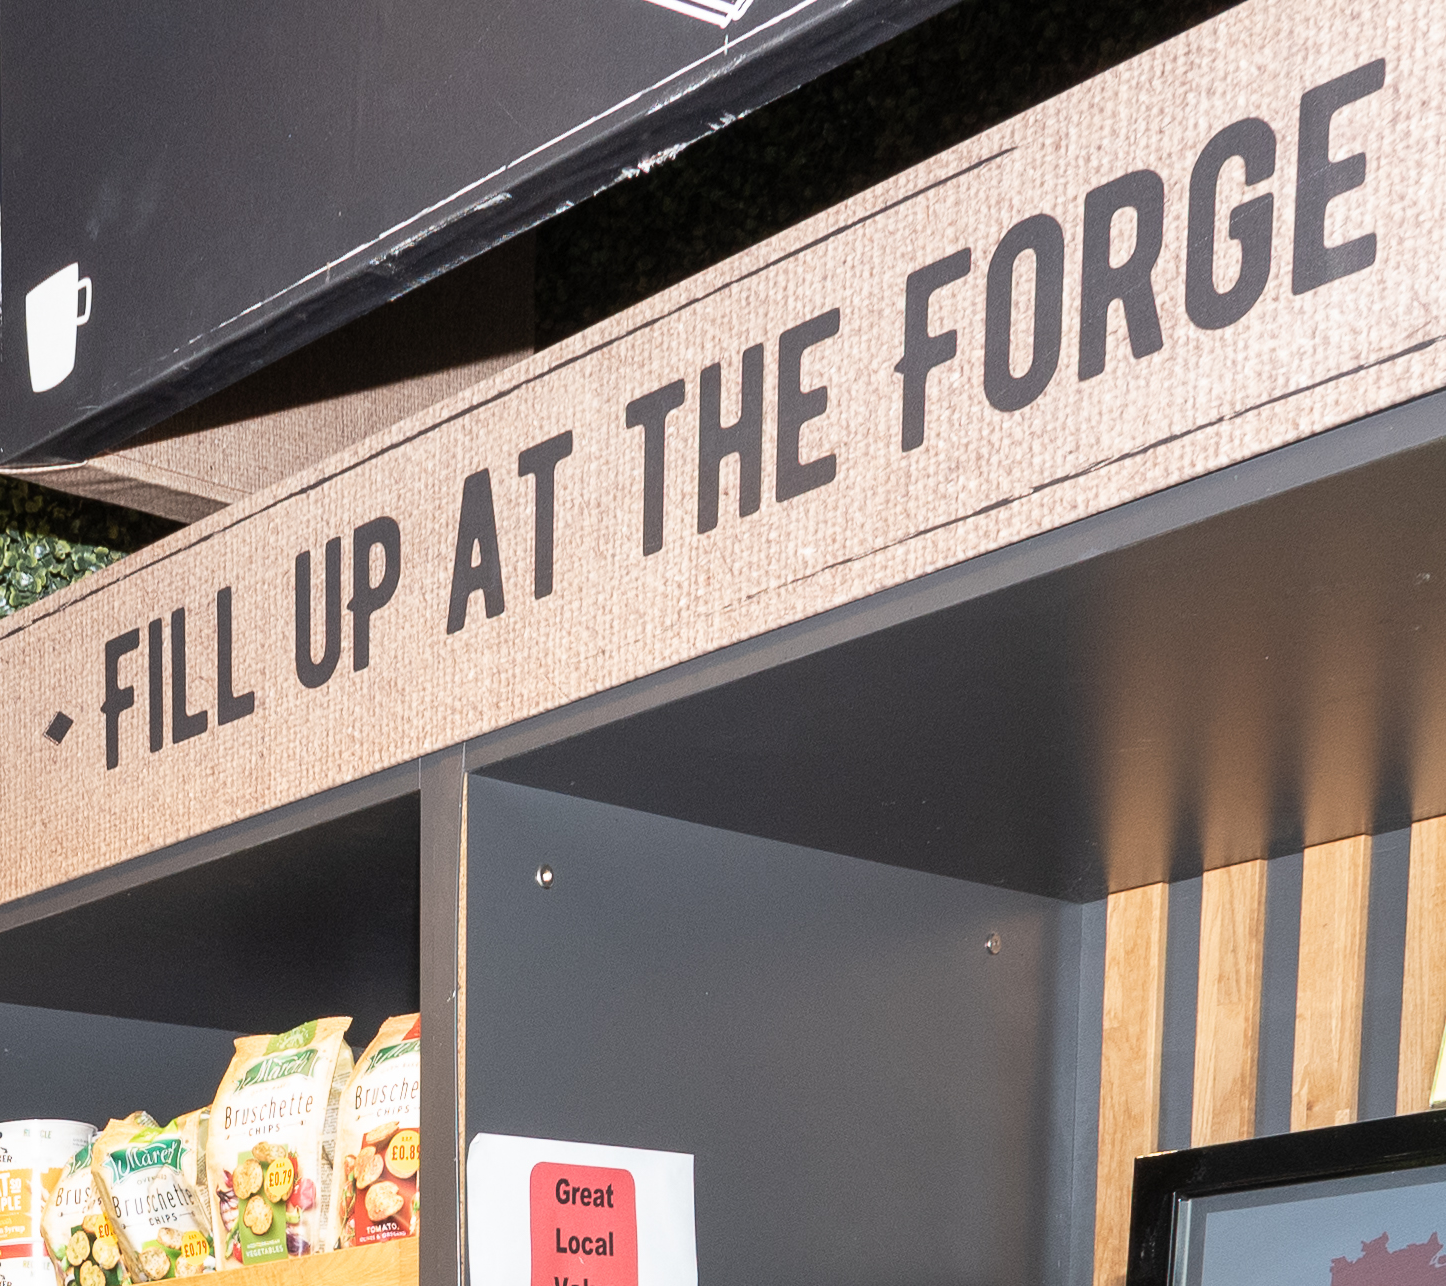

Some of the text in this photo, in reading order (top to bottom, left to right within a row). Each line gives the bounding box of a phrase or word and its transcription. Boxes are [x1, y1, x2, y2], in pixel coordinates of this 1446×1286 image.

[100, 589, 255, 771] FILL
[294, 515, 402, 689] UP
[446, 432, 574, 636] AT
[625, 307, 842, 558] THE
[894, 57, 1386, 453] FORGE
[223, 1092, 315, 1131] Bruschette
[248, 1123, 282, 1138] CHIPS
[268, 1169, 293, 1189] £0.79
[554, 1177, 615, 1209] Great
[112, 1183, 195, 1219] Bruschette
[245, 1244, 285, 1259] VEGETABLES
[554, 1227, 615, 1257] Local
